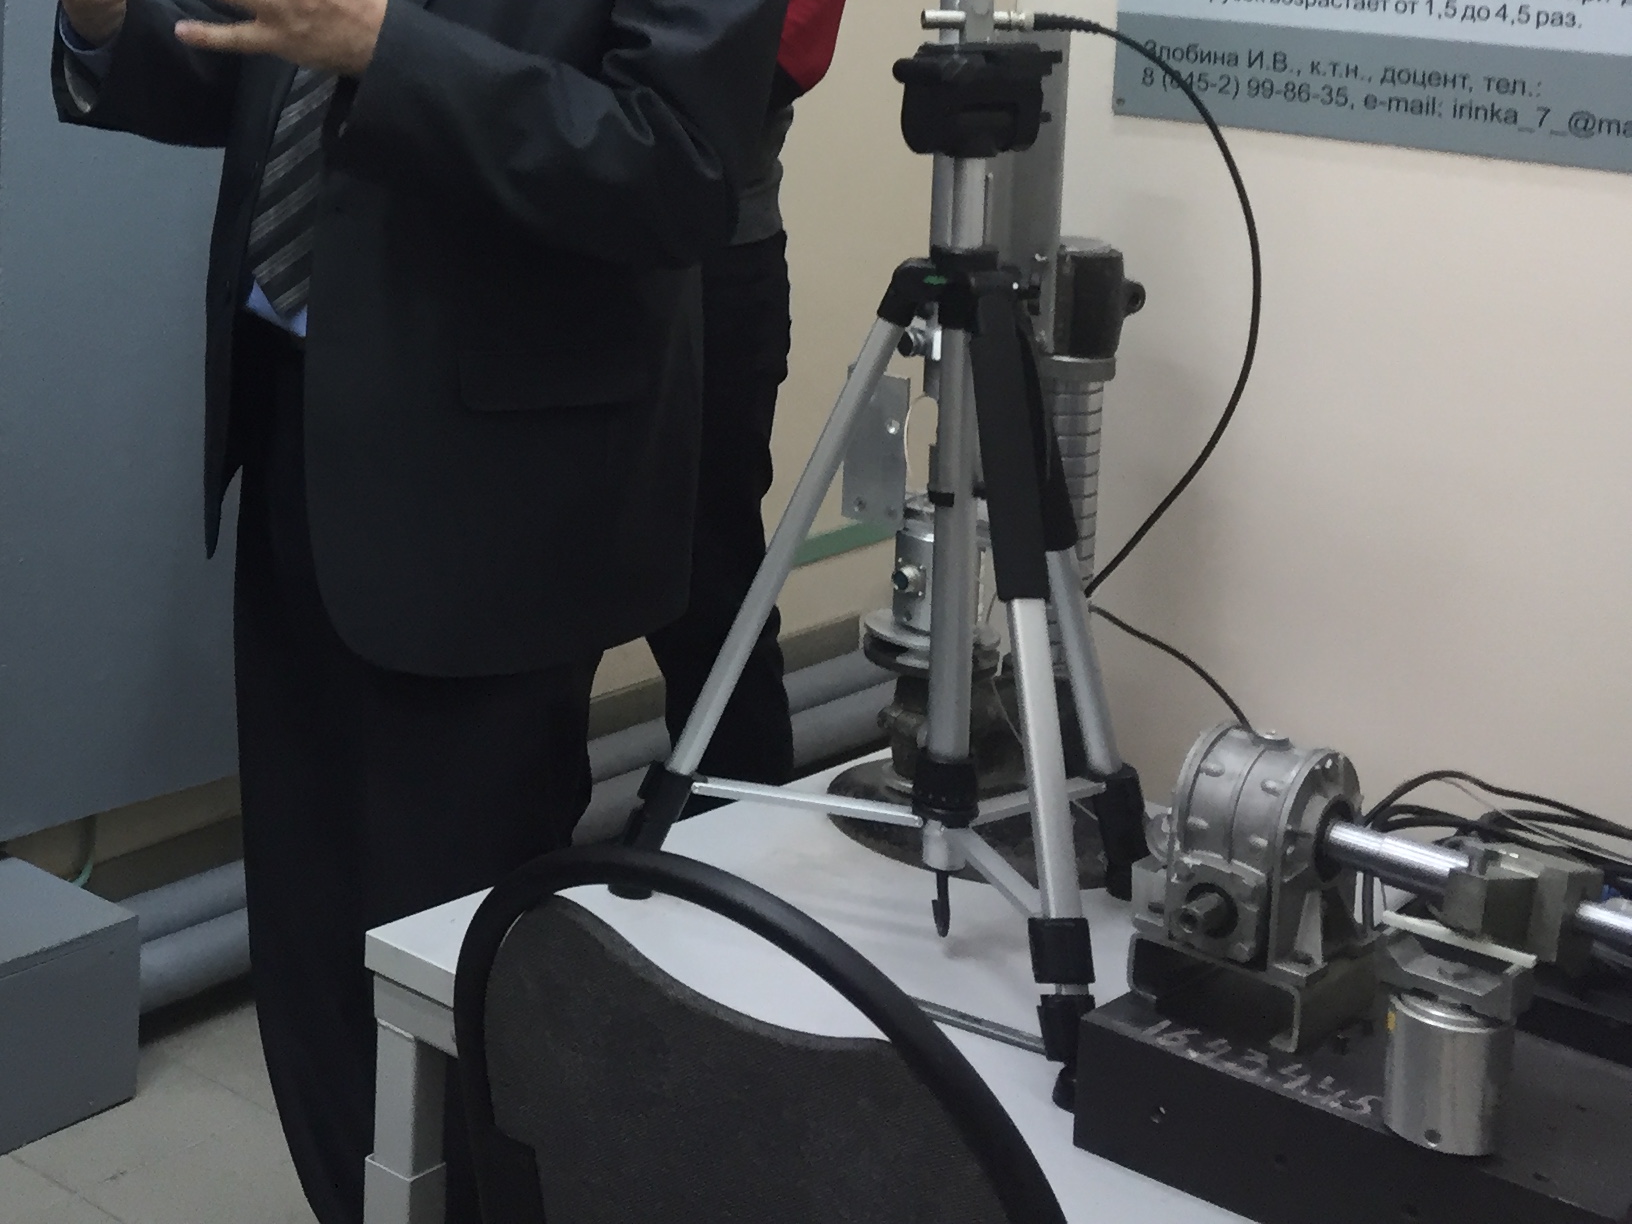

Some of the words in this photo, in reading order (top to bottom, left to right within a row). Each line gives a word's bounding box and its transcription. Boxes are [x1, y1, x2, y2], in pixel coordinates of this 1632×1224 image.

[1395, 0, 1419, 15] от
[1461, 5, 1490, 23] до
[1495, 3, 1530, 25] 4,5
[1536, 10, 1582, 29] раз.
[1141, 67, 1154, 87] 8
[1247, 76, 1354, 110] 99-86-35,
[1363, 93, 1443, 118] e-mail:
[1247, 50, 1301, 77] И.В.,
[1380, 66, 1473, 93] доцент,
[1483, 75, 1541, 97] тел.:
